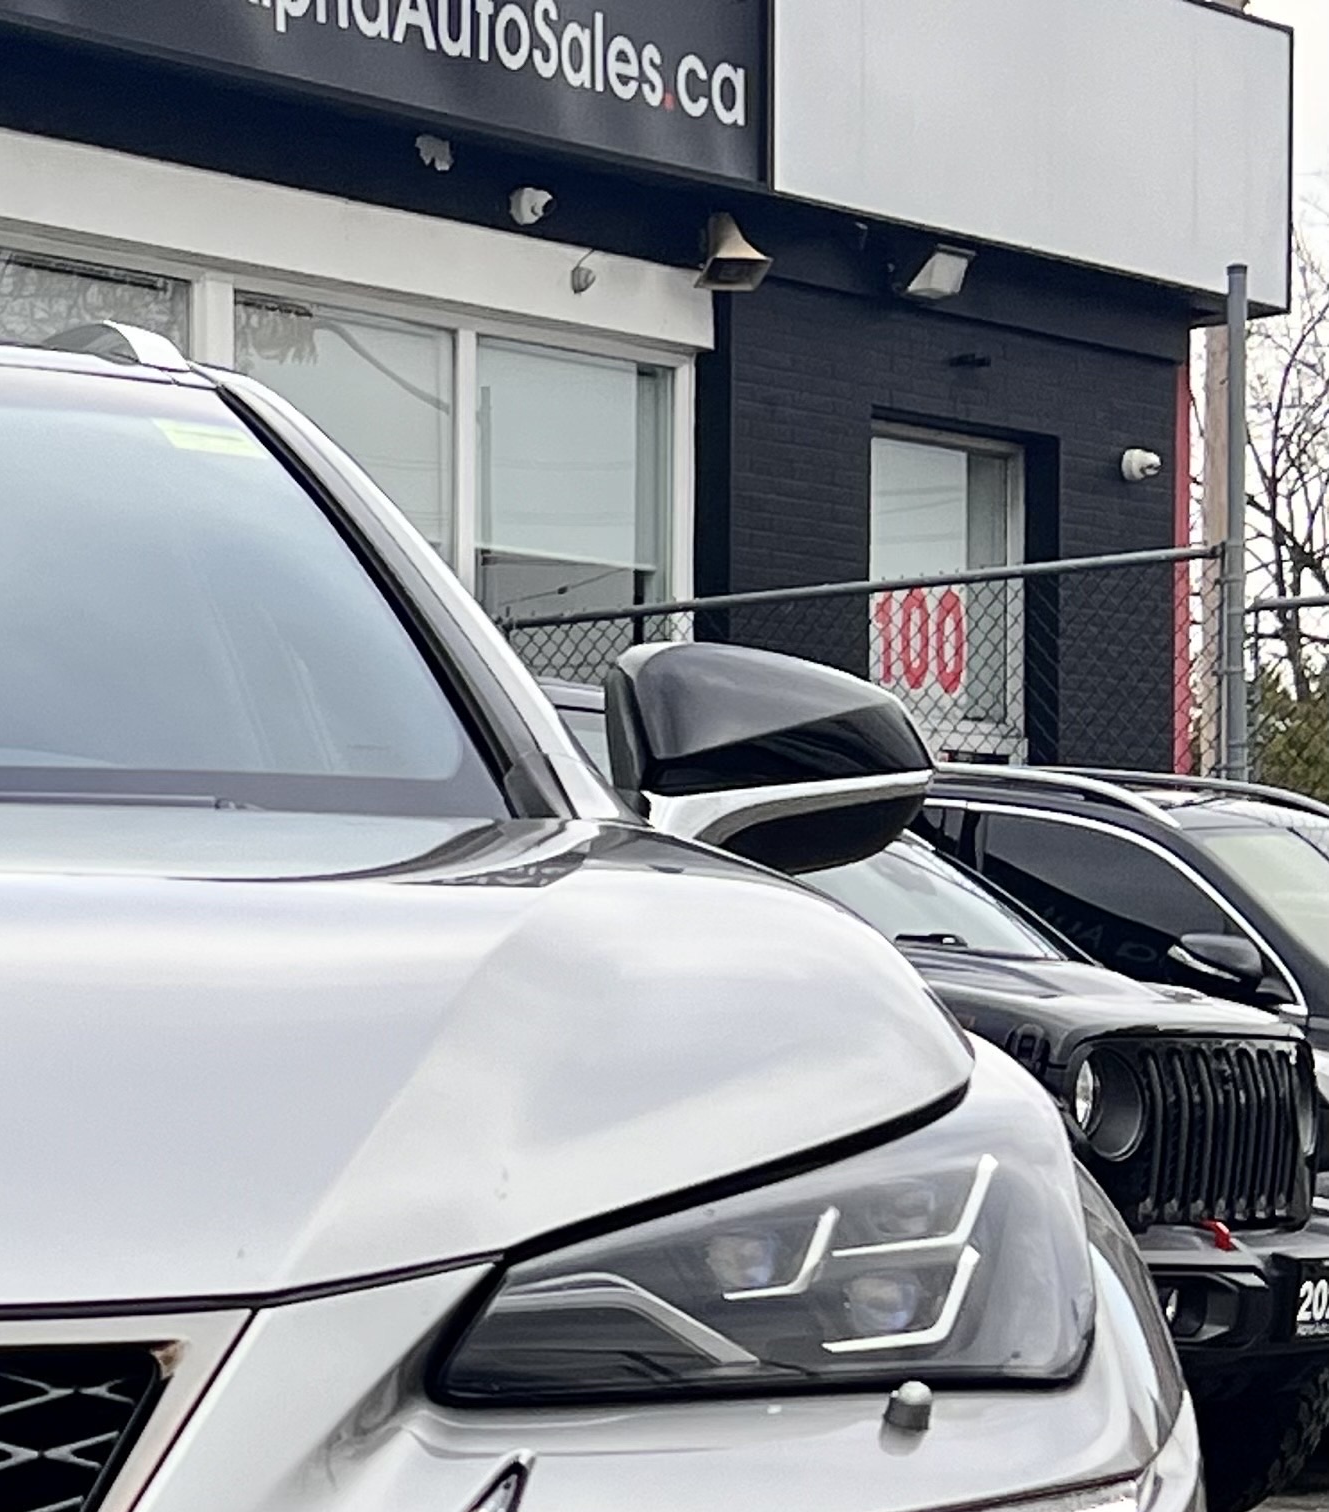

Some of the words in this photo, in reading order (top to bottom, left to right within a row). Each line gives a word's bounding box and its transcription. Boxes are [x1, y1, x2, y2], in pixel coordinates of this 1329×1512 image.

[247, 0, 746, 127] aAutoSales.ca
[874, 586, 964, 694] 100
[1295, 1278, 1329, 1323] 20
